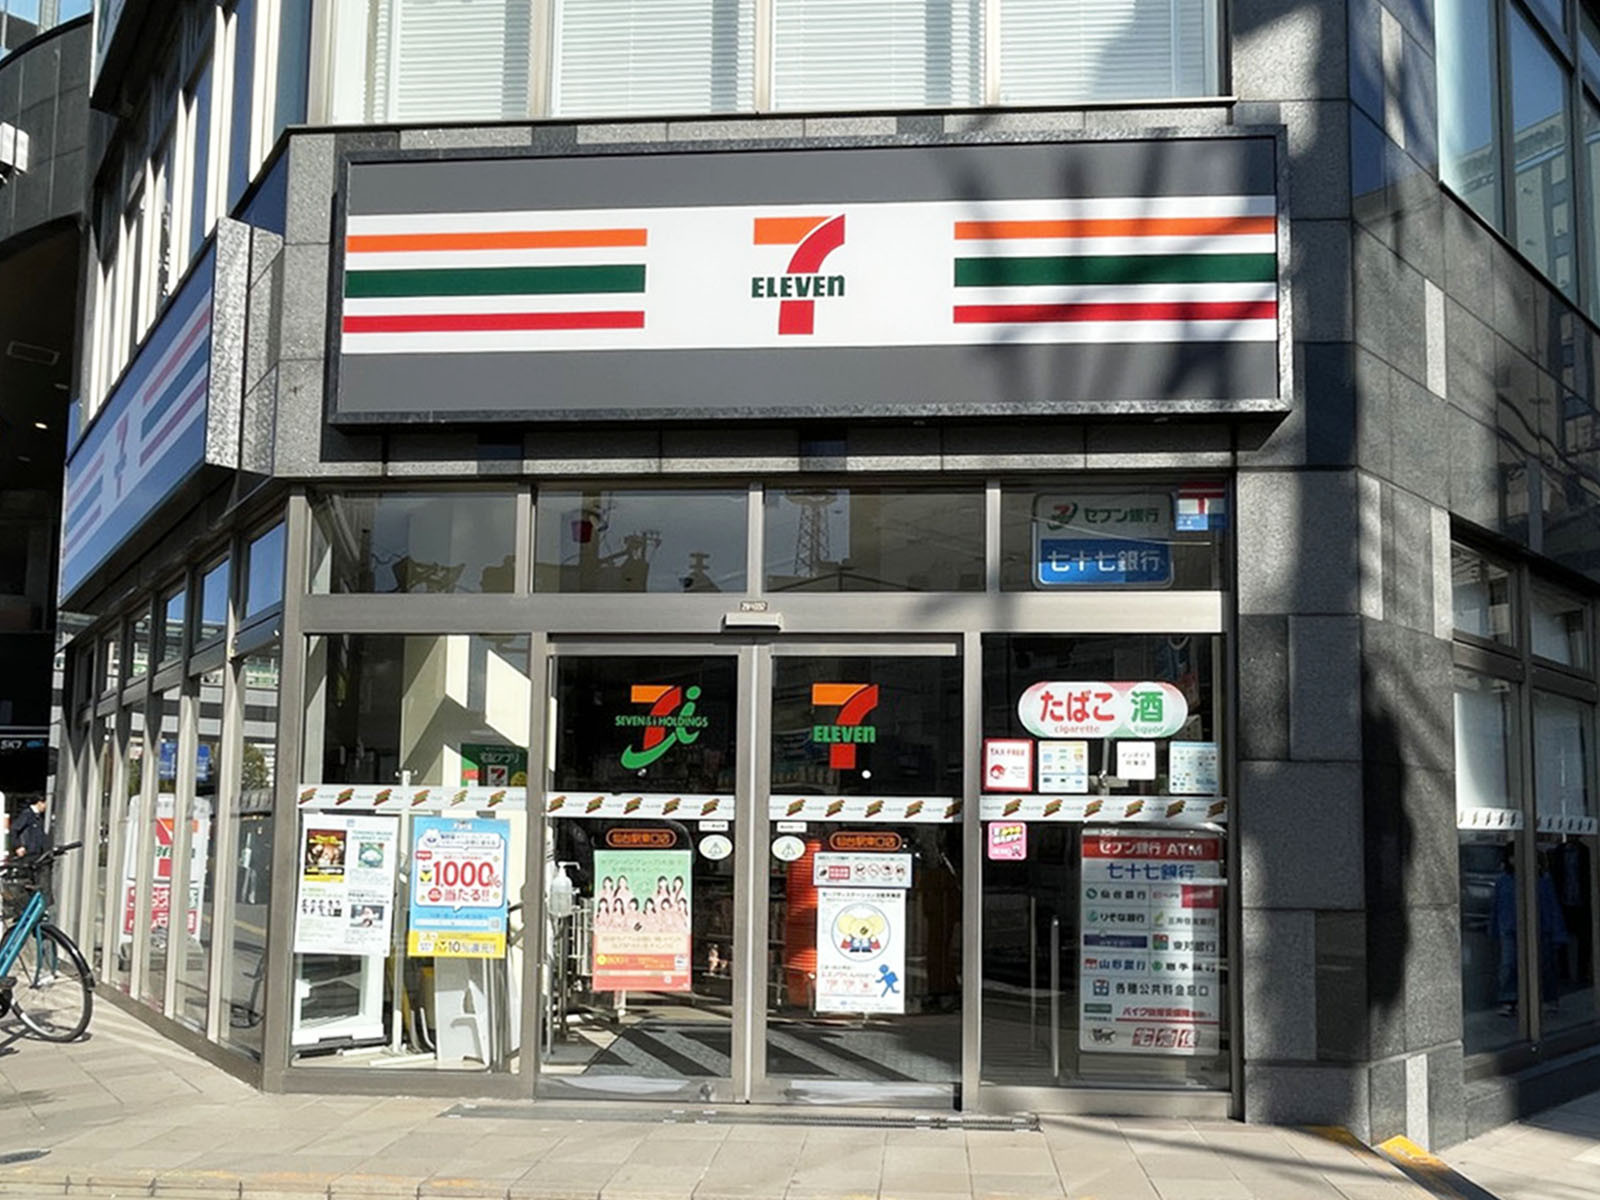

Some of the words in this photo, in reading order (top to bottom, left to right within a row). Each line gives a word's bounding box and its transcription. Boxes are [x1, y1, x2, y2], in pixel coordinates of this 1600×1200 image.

[1084, 507, 1159, 523] セブン銀行
[1047, 549, 1160, 572] 七十七銀行
[1040, 690, 1115, 722] たばこ
[1131, 691, 1164, 722] 酒
[1054, 724, 1101, 733] cigarette
[1099, 841, 1161, 855] セブン銀行
[1166, 843, 1203, 856] ATM
[1106, 862, 1195, 880] 七十七銀行
